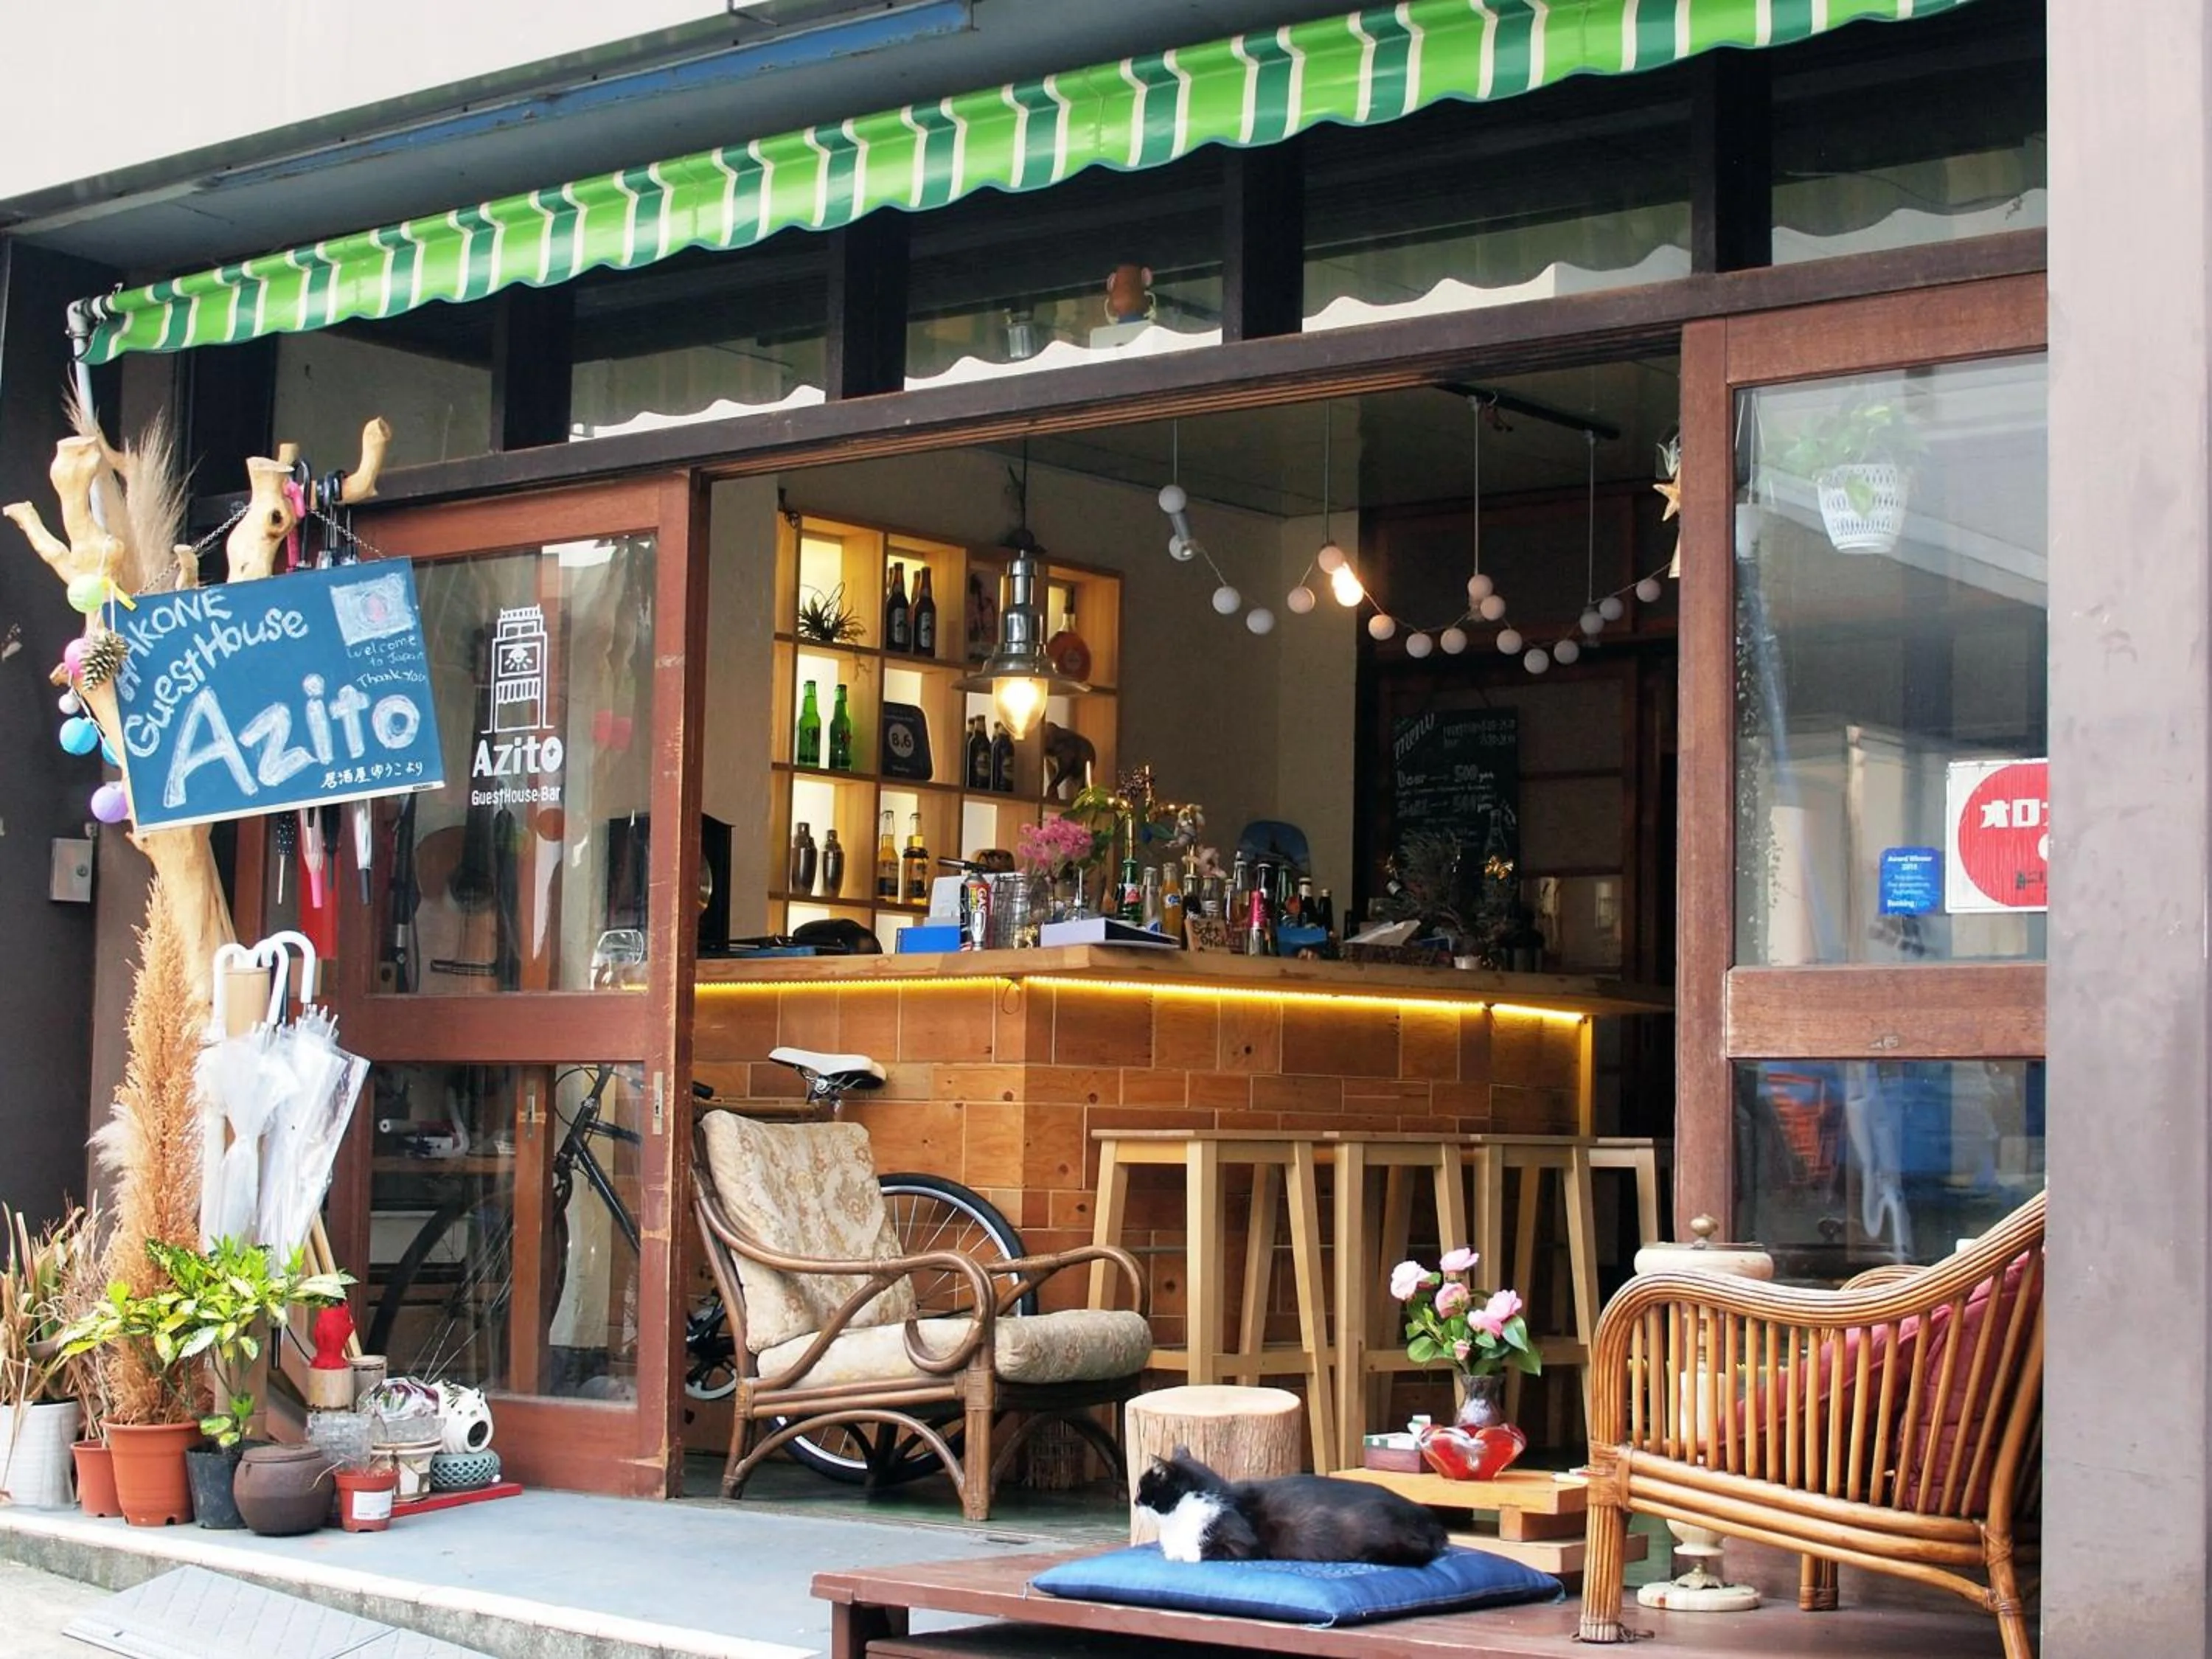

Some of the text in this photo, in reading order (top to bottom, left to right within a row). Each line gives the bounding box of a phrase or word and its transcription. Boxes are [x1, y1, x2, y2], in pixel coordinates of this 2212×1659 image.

[163, 672, 420, 808] Azito
[472, 736, 563, 778] Azito
[1980, 799, 2048, 829] オロ
